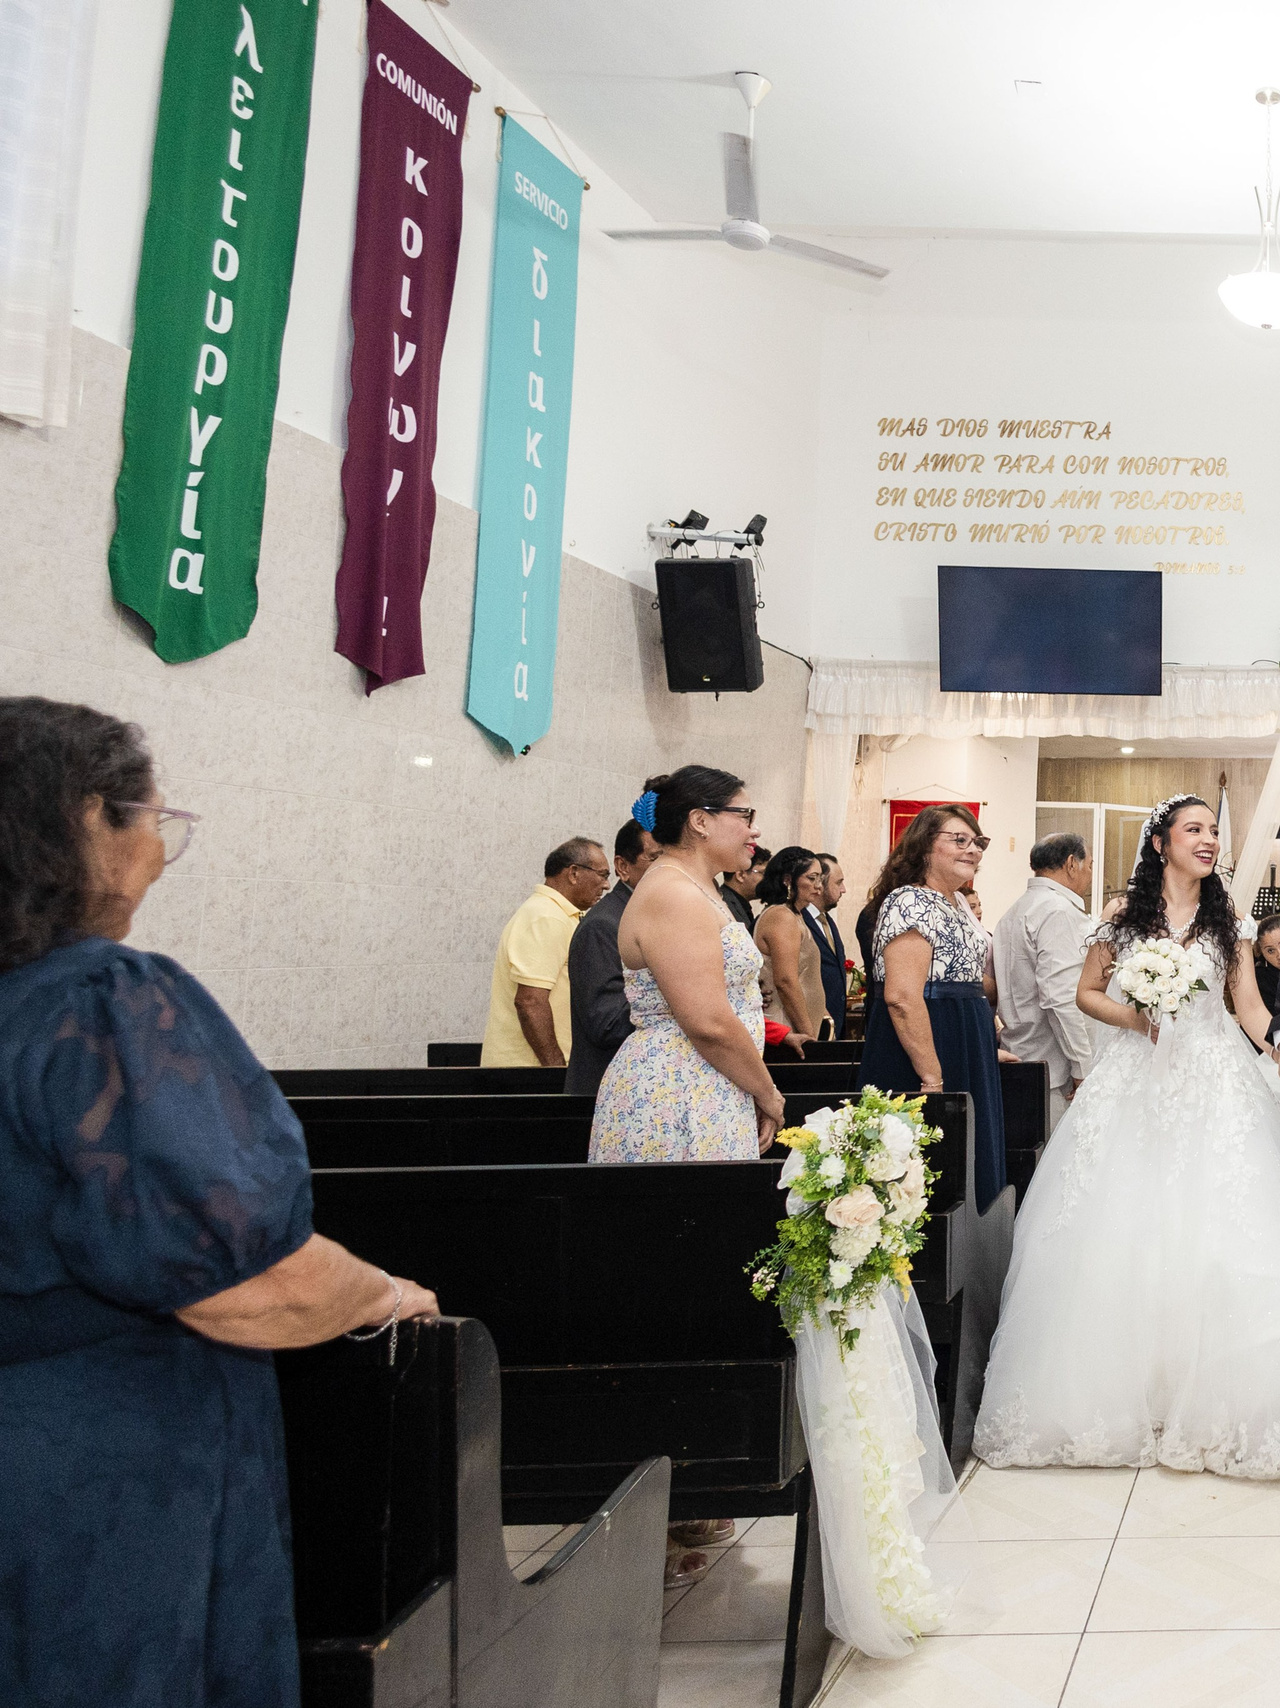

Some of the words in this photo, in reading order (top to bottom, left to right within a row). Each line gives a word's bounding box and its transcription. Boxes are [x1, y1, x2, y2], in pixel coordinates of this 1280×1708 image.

[376, 53, 458, 135] COMUNIÓN
[514, 171, 568, 230] SERVICIO
[877, 417, 930, 439] MAS
[936, 418, 989, 439] DIOS
[997, 419, 1113, 442] MUESTRA
[877, 452, 909, 474] SU
[913, 453, 987, 475] AMOR
[993, 455, 1056, 476] PARA
[1063, 455, 1110, 476] CON
[1117, 457, 1231, 480] NOSOTROS,
[875, 487, 909, 508] EN
[913, 488, 960, 510] QUE
[963, 488, 1048, 510] SIENDO
[1050, 485, 1104, 511] AÚN
[1109, 491, 1247, 515] PECADORES,
[873, 521, 960, 543] CRISTO
[968, 520, 1052, 545] MURIÓ
[1058, 524, 1108, 545] POR
[1114, 525, 1231, 547] NOSOTROS.
